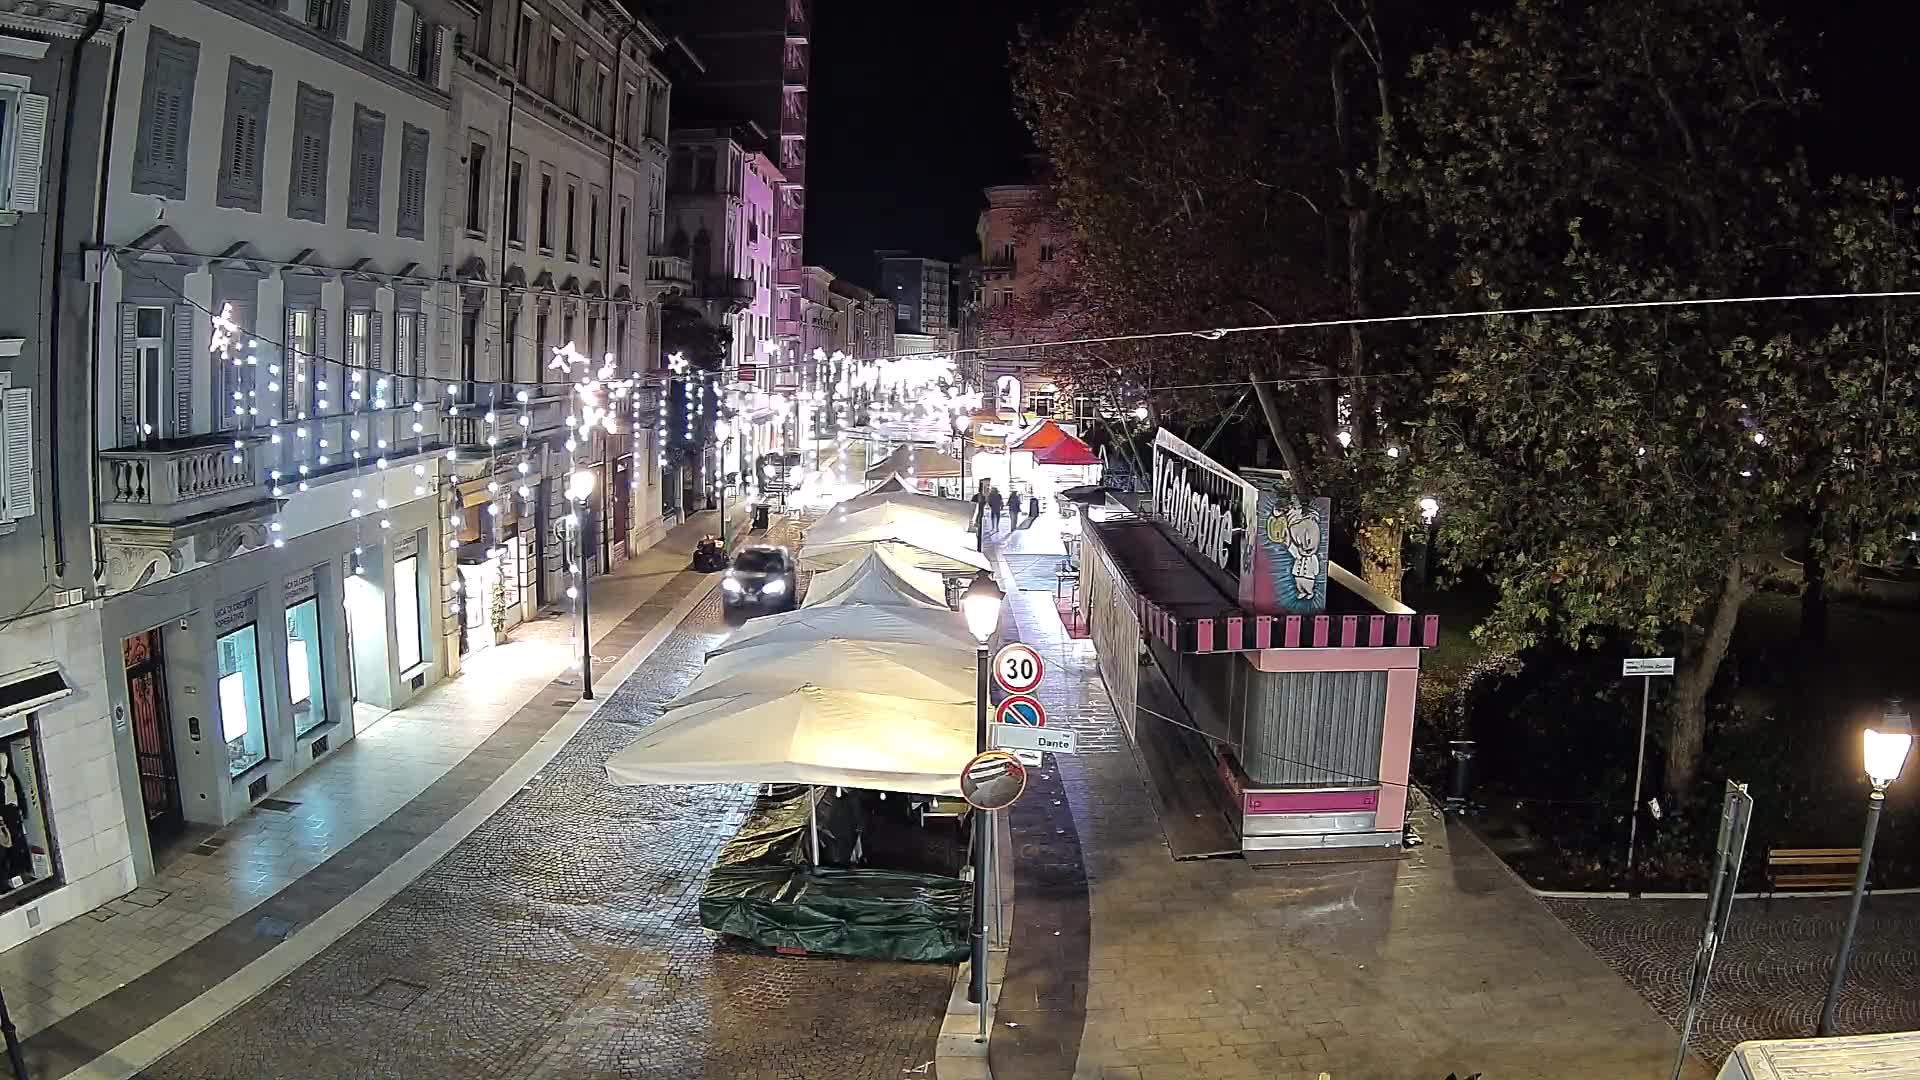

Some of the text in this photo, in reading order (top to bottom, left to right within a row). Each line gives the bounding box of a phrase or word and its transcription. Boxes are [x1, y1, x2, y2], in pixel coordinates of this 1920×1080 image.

[1162, 458, 1233, 570] Golosone
[1006, 658, 1033, 680] 30
[1038, 737, 1070, 749] Dante
